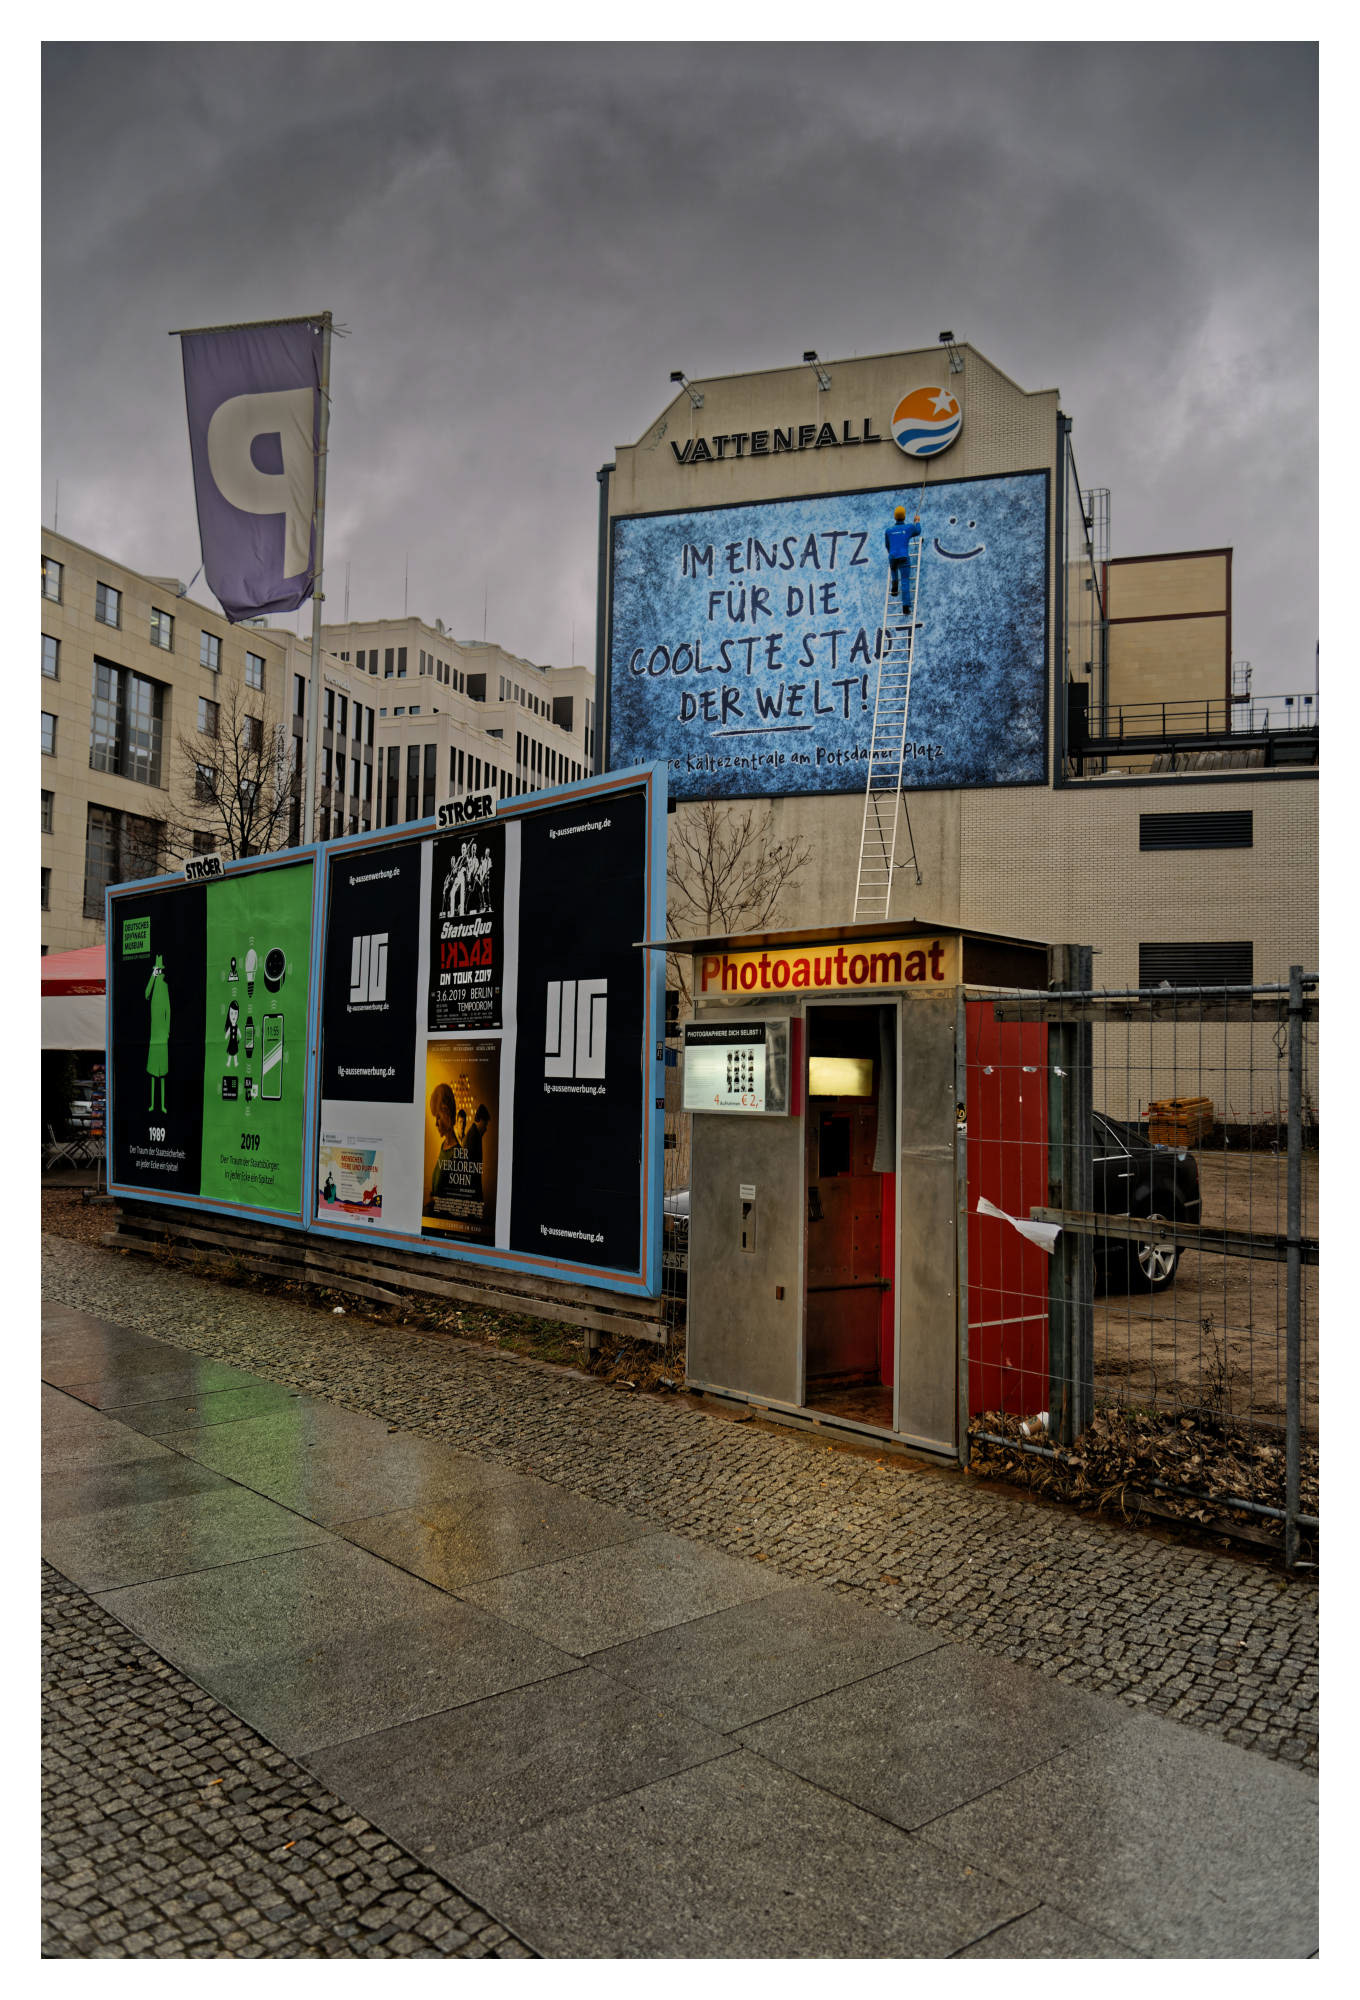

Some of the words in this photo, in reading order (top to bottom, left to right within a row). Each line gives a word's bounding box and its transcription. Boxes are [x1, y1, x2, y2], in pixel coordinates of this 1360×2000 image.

[670, 417, 880, 463] VATTENFALL
[682, 543, 714, 578] IM
[725, 531, 870, 573] EINSATZ
[707, 581, 772, 623] FÜR
[787, 582, 840, 616] DIE
[630, 632, 783, 677] COOLSTE
[799, 623, 923, 670] STADT
[680, 686, 743, 724] DER
[756, 674, 868, 719] WELT!
[687, 750, 785, 772] Kältezentrale
[790, 753, 810, 765] am
[903, 742, 943, 761] Platz
[439, 795, 493, 826] STRÖER
[549, 818, 612, 839] ilg-aussenwerbung.de
[186, 858, 222, 880] STRÖER
[349, 867, 400, 886] ilg-aussenwerbung.de
[700, 941, 946, 992] Photoautomat
[440, 972, 451, 986] ON
[453, 971, 473, 985] TOUR
[474, 969, 492, 983] 2019
[436, 989, 466, 1002] 3.6.2019
[470, 987, 493, 1000] BERLIN
[457, 1001, 493, 1012] TEMPODROM
[687, 1030, 727, 1038] PHOTOGRAPHIERE
[728, 1029, 740, 1037] DICH
[337, 1065, 396, 1079] ilg-aussenwerbung.de
[543, 1082, 606, 1097] ilg-aussenwerbung.de
[149, 1127, 166, 1142] 1989
[241, 1133, 260, 1151] 2019
[453, 1147, 470, 1160] DER
[438, 1160, 484, 1174] VERLORENE
[449, 1172, 472, 1186] SOHN
[540, 1224, 604, 1243] ilg-aussenwerbung.de
